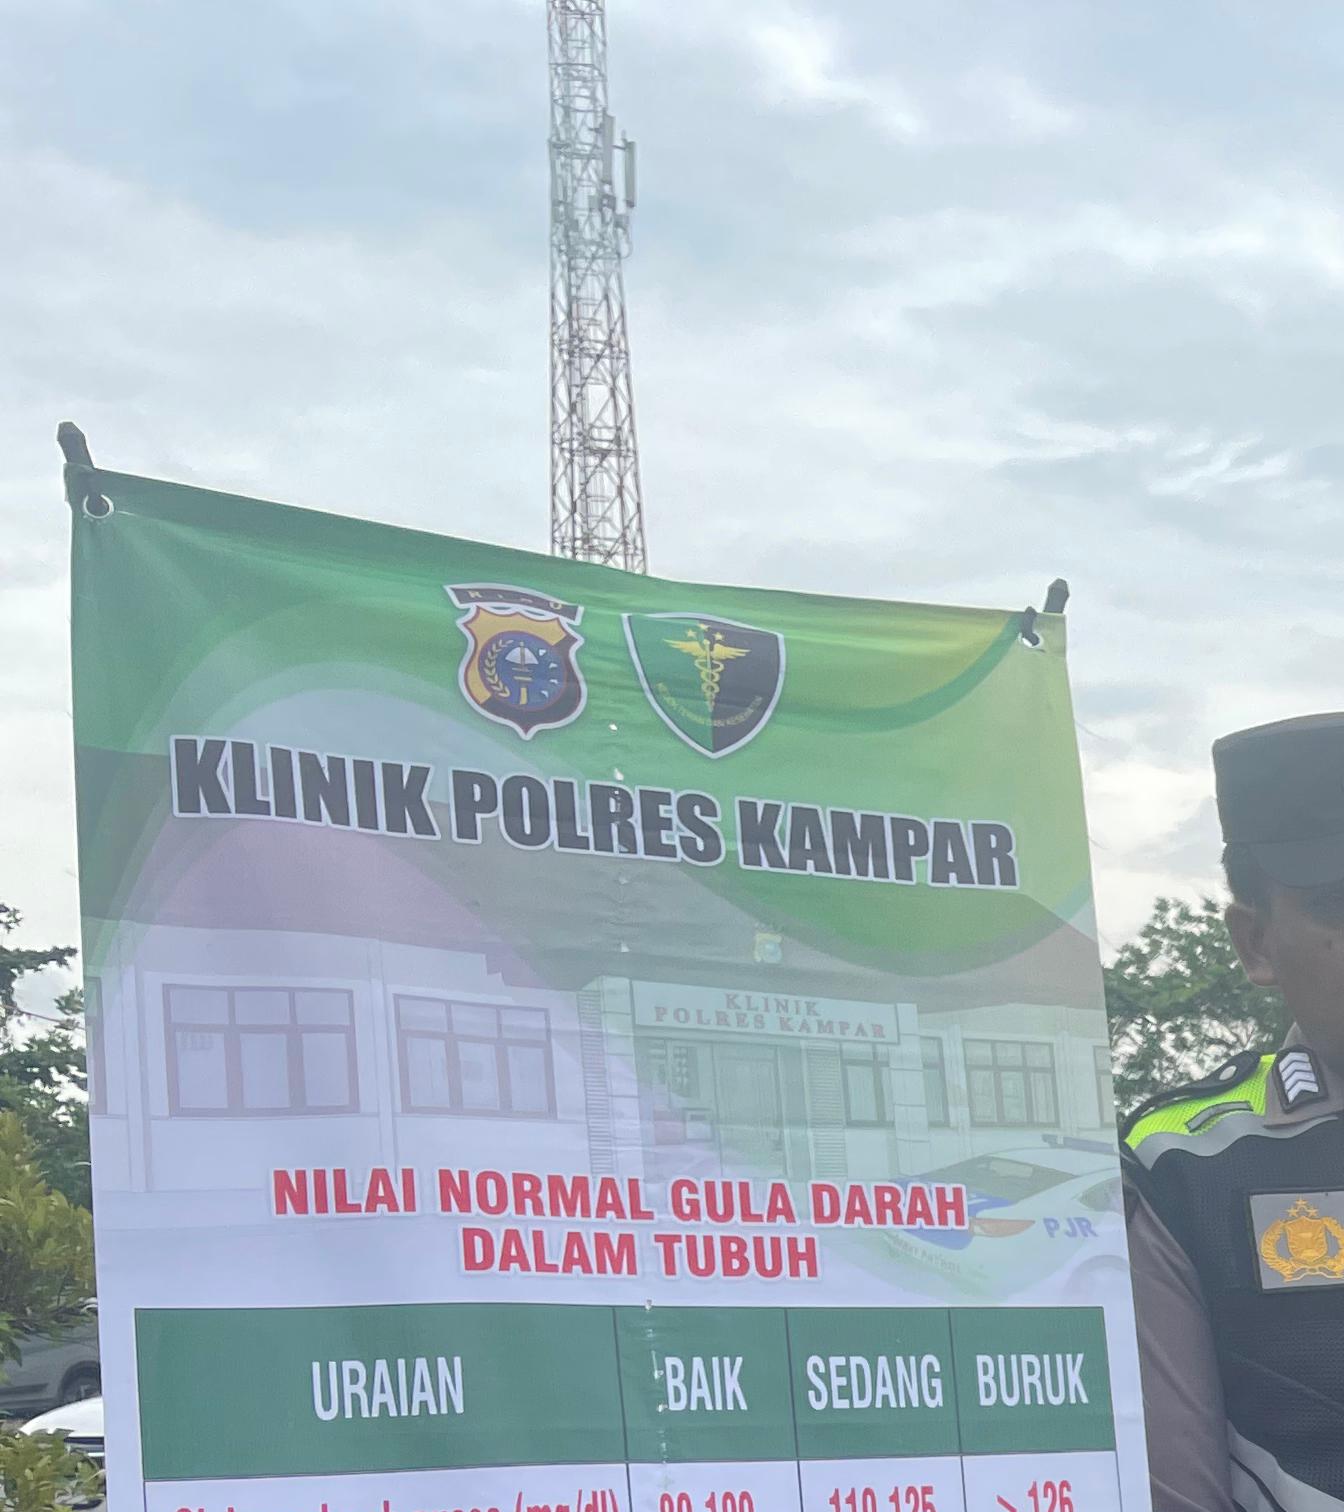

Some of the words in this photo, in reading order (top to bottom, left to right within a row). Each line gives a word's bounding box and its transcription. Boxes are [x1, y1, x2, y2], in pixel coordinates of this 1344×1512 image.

[174, 737, 438, 837] KLINIK
[452, 769, 723, 863] POLRES
[738, 800, 1017, 886] KAMPAR
[654, 1006, 766, 1029] POLRES
[779, 1016, 886, 1038] KAMPAR
[725, 993, 822, 1016] KLINIK
[274, 1169, 416, 1214] NILAI
[439, 1169, 653, 1220] NORMAL
[672, 1180, 794, 1223] GULA
[812, 1184, 964, 1226] DARAH
[463, 1228, 636, 1275] DALAM
[655, 1234, 817, 1278] TUBUH
[1042, 1217, 1098, 1238] PJR
[312, 1356, 464, 1421] URAIAN
[664, 1356, 748, 1410] BAIK
[806, 1354, 943, 1409] SEDANG
[976, 1353, 1089, 1406] BURUK
